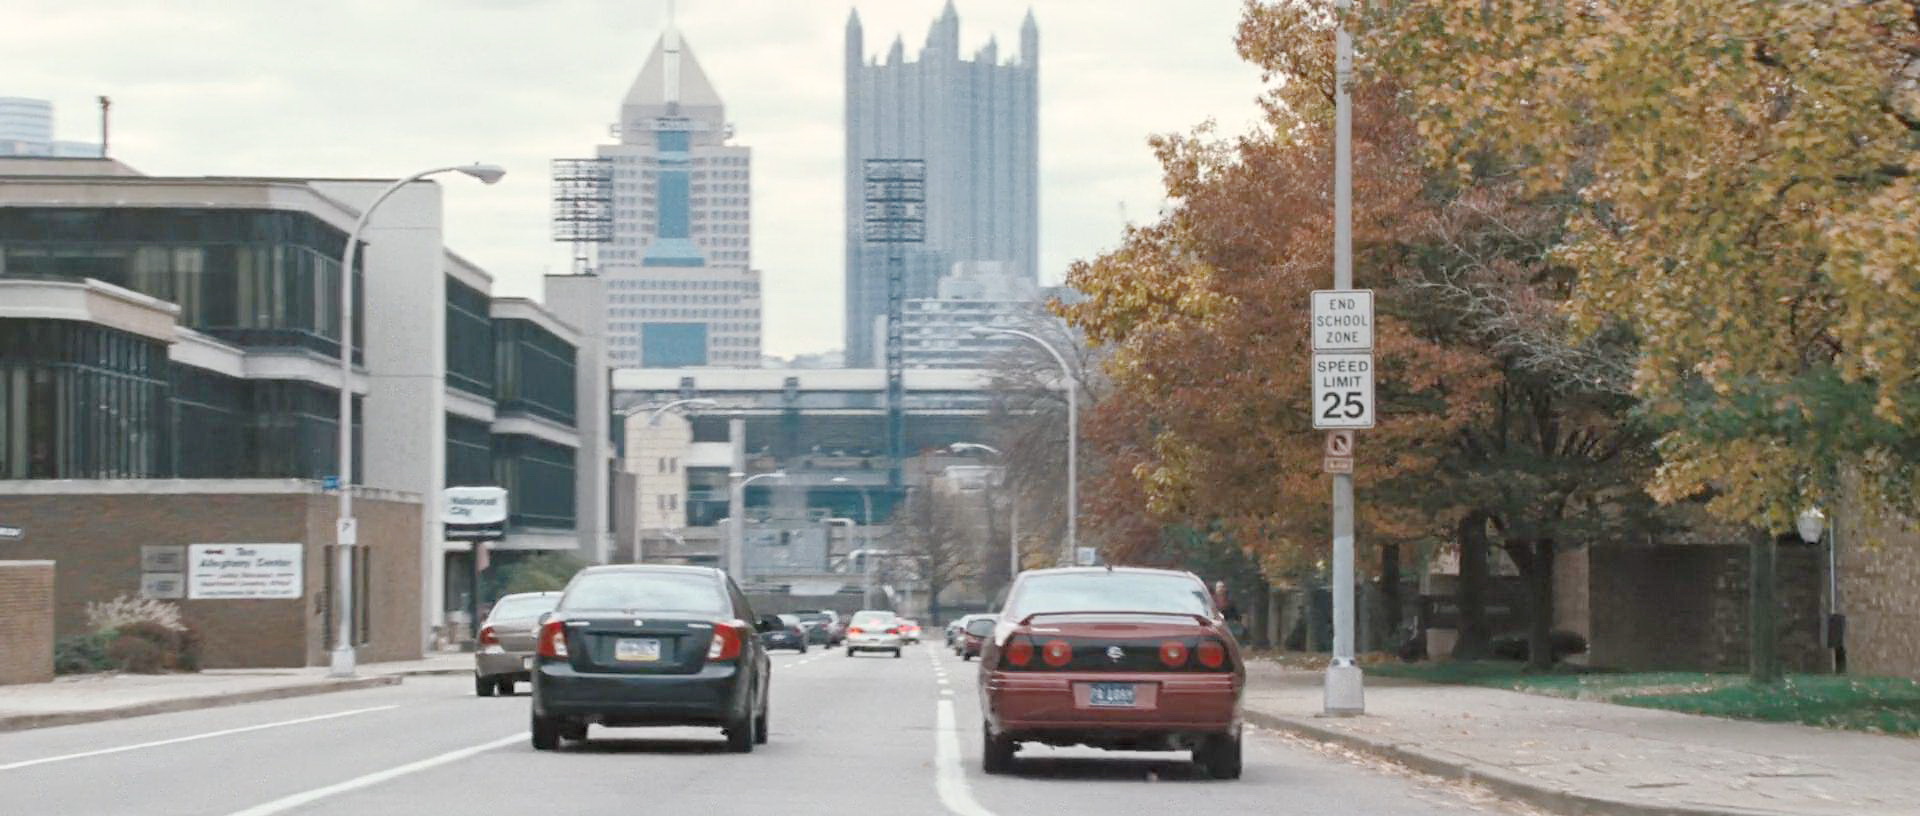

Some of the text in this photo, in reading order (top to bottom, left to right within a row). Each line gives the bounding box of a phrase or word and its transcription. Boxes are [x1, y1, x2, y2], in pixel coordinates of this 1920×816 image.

[1329, 298, 1356, 311] END
[1317, 315, 1368, 327] SCHOOL
[1326, 331, 1359, 344] ZONE
[1317, 360, 1369, 372] SPEED
[1323, 376, 1362, 388] LIMIT
[1322, 391, 1365, 419] 25
